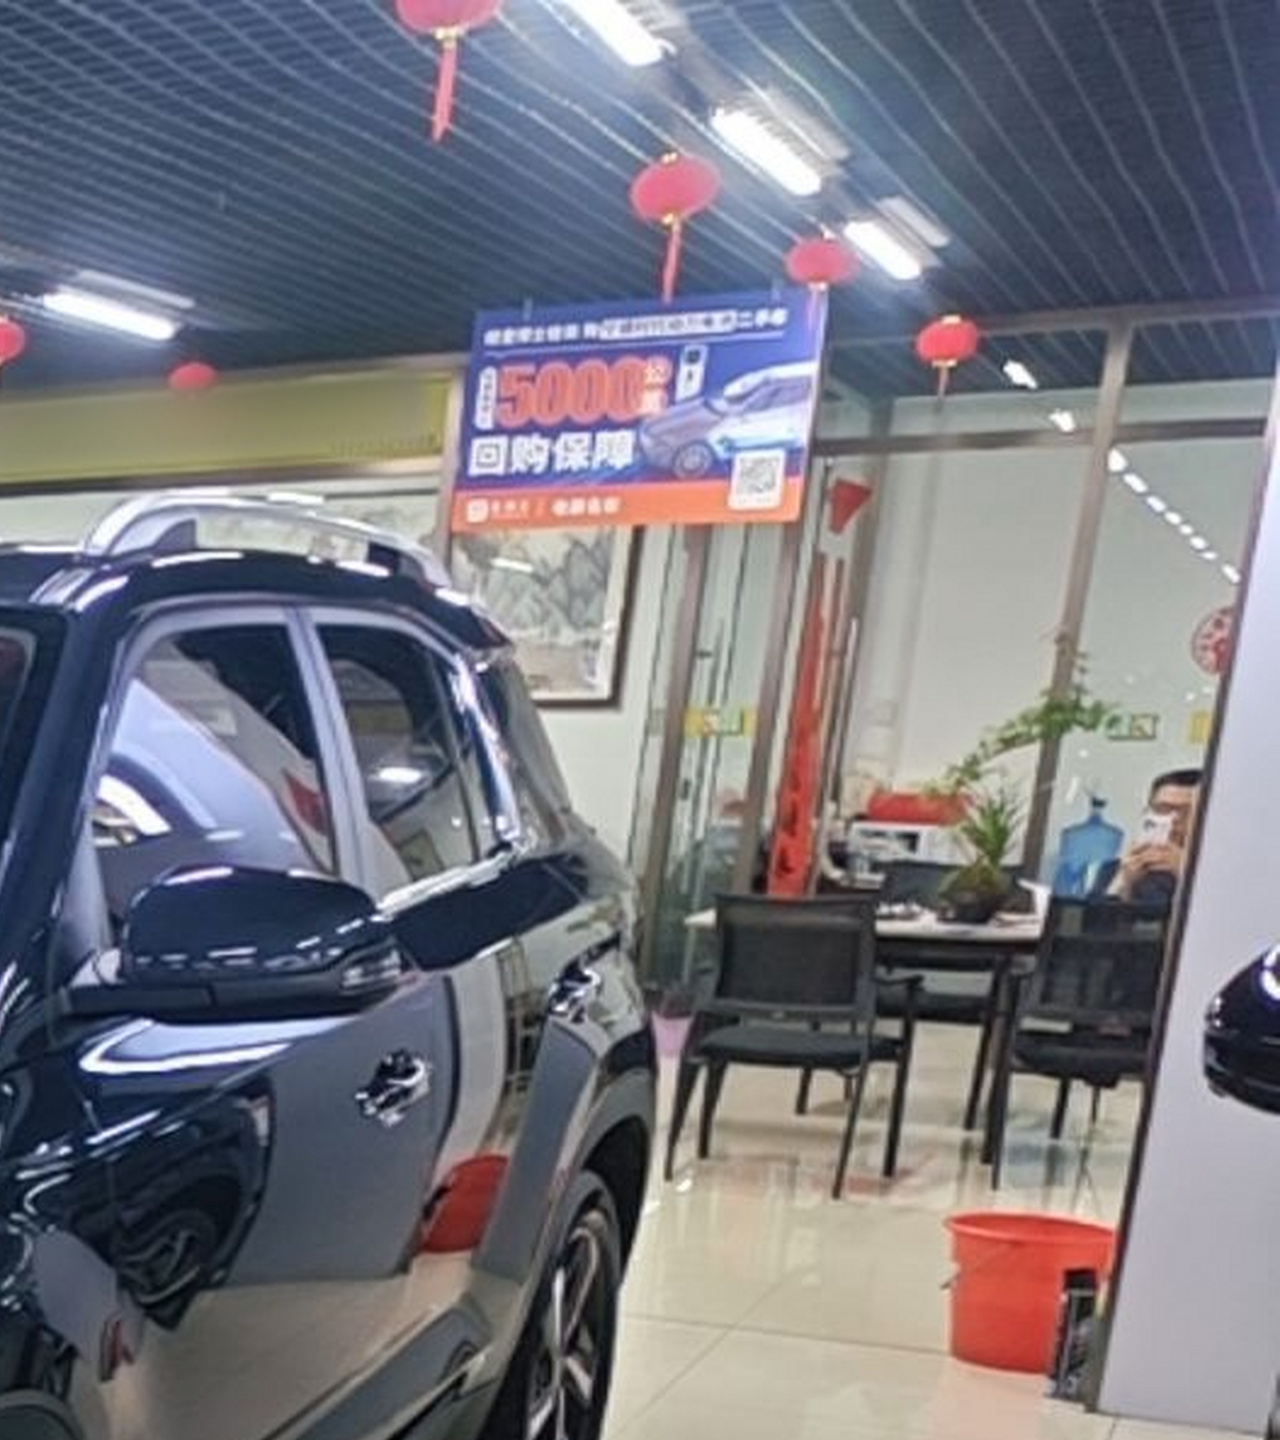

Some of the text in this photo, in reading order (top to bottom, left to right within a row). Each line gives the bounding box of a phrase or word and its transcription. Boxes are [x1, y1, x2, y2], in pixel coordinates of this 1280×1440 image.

[497, 357, 644, 428] 5000
[467, 429, 637, 477] 回购保障
